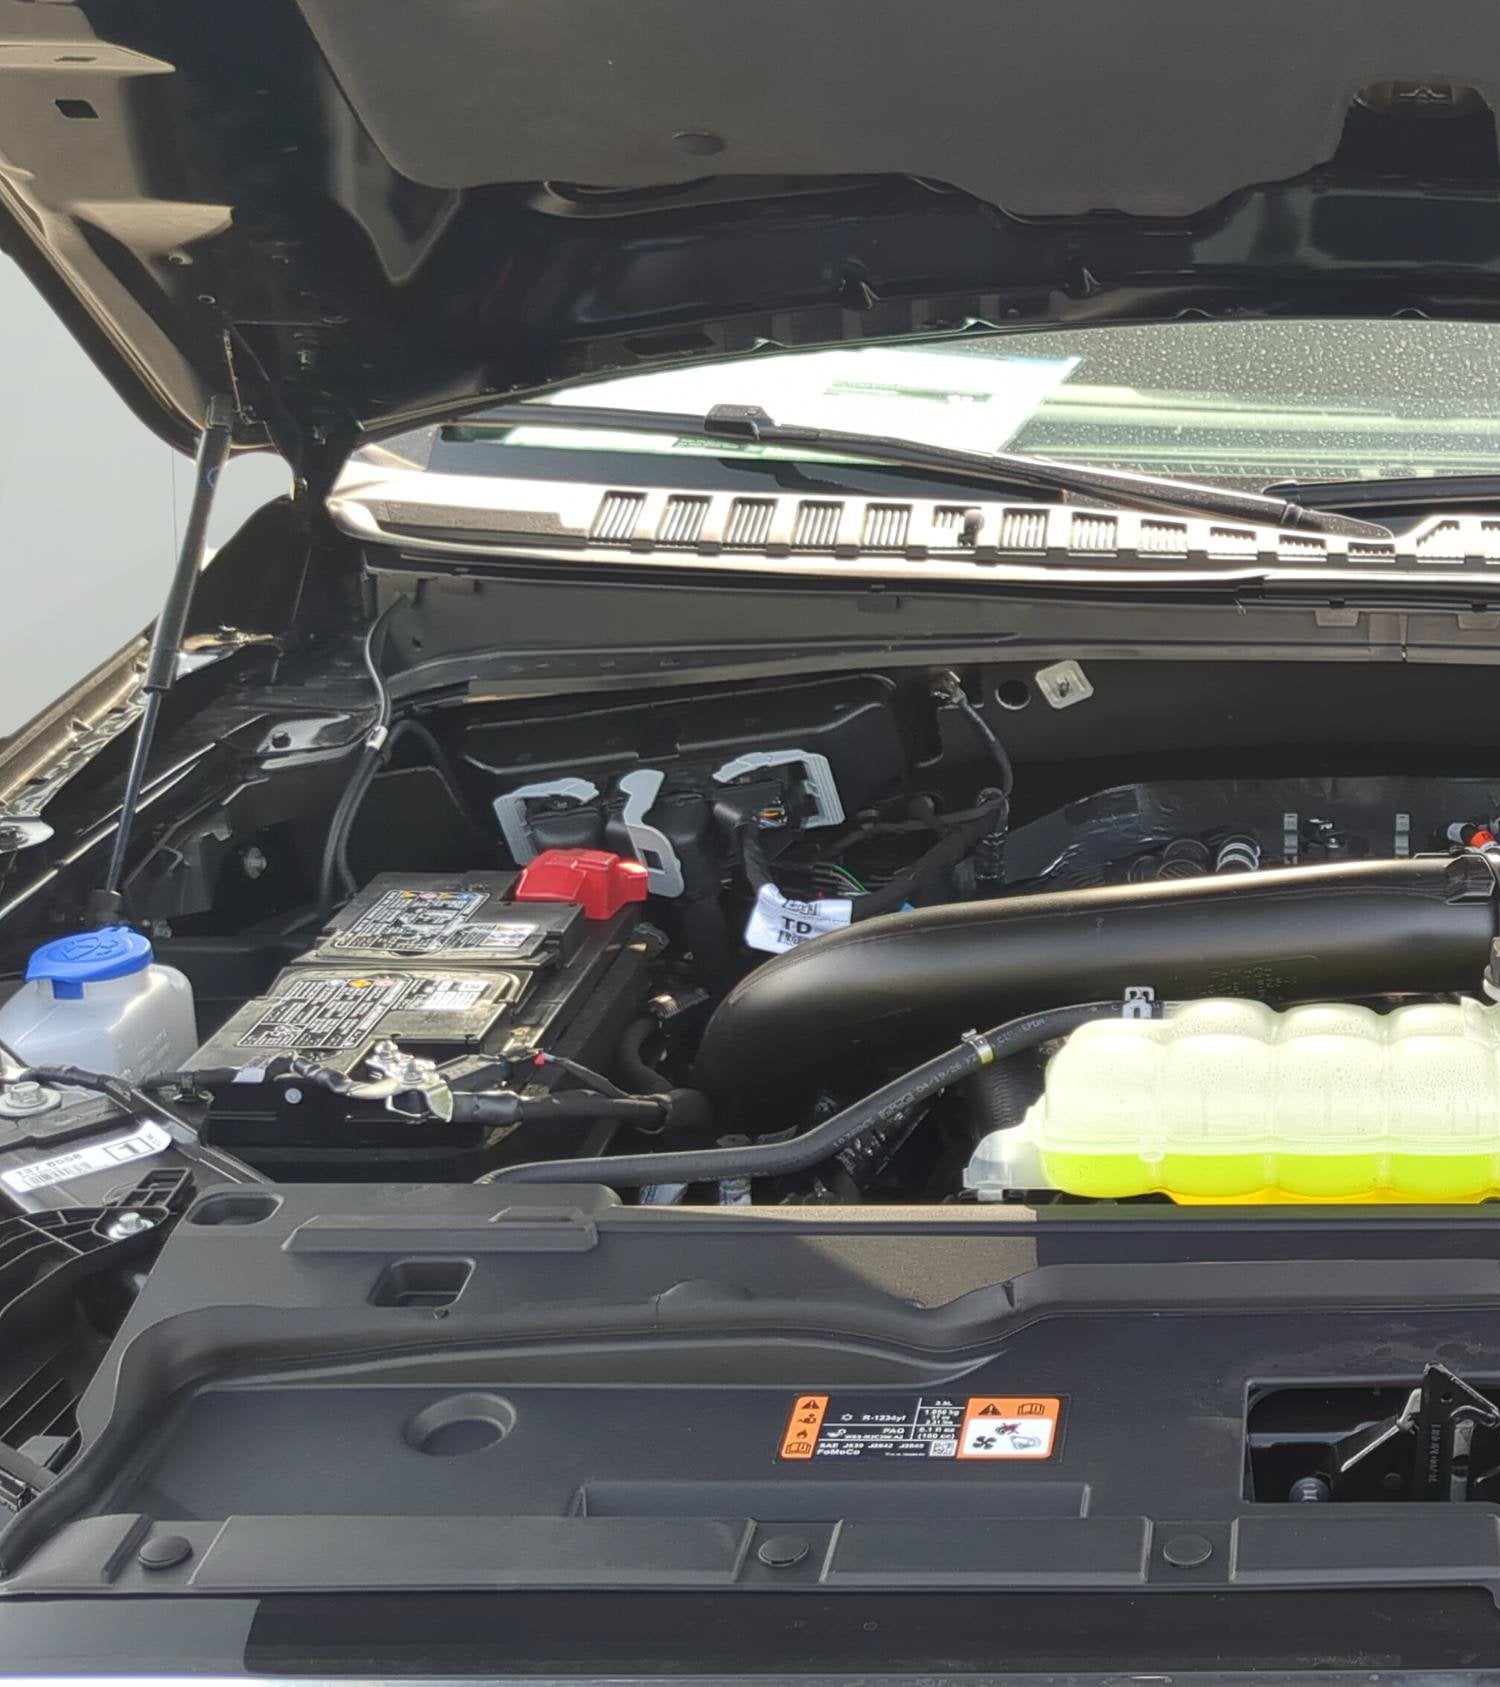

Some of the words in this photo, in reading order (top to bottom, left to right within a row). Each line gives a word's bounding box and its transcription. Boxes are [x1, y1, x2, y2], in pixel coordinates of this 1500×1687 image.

[781, 916, 813, 934] TD
[862, 1414, 907, 1422] R-1234yf
[816, 1448, 861, 1456] FoMoCo
